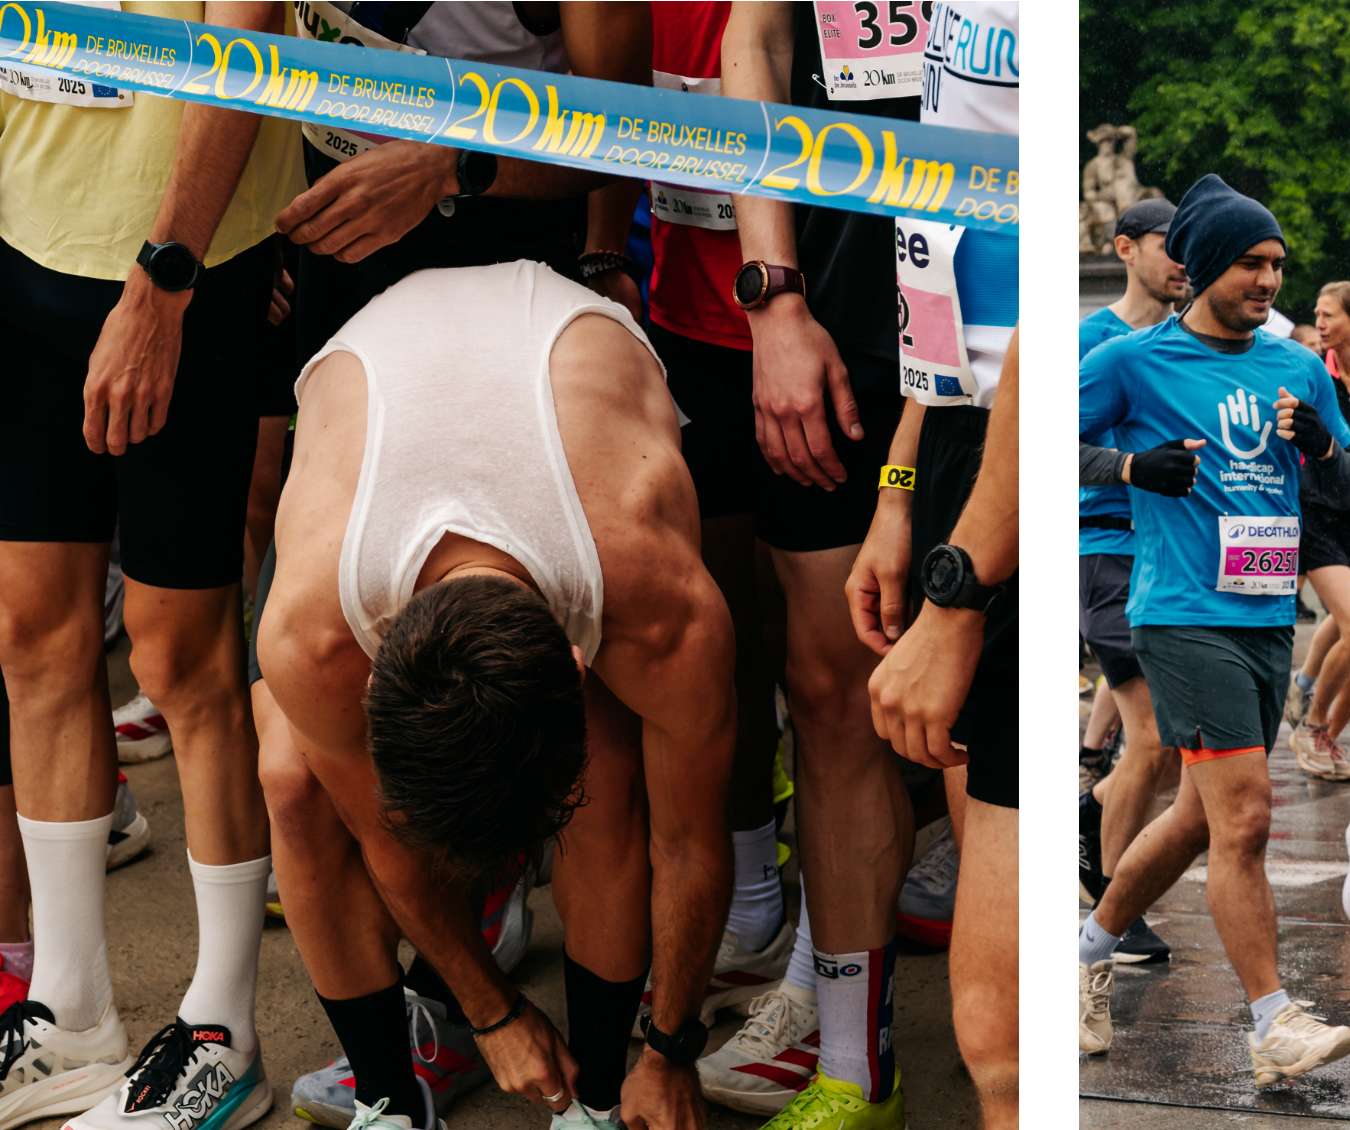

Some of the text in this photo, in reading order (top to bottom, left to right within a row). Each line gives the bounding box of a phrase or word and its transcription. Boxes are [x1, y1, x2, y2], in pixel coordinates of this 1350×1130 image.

[22, 8, 78, 69] km
[824, 28, 841, 38] ELITE
[86, 36, 176, 67] DE BRUXELLES
[57, 77, 86, 95] 2025
[72, 59, 176, 87] DOOR BRUSSEL
[183, 33, 319, 112] 20 km
[863, 70, 880, 87] 20
[880, 69, 897, 86] km
[327, 73, 436, 109] DE BRUXELLES
[314, 99, 436, 134] DOOR BRUSSEL
[443, 71, 606, 159] 20 km
[325, 132, 358, 156] 2025
[616, 116, 748, 157] DE BRUXELLES
[602, 144, 748, 184] DOOR BRUSSEL
[760, 115, 955, 212] 20 km
[969, 165, 1001, 193] DE
[904, 366, 929, 391] 2025
[1226, 388, 1260, 432] Hi
[193, 1030, 225, 1041] HOKA
[164, 1061, 236, 1130] HOKA
